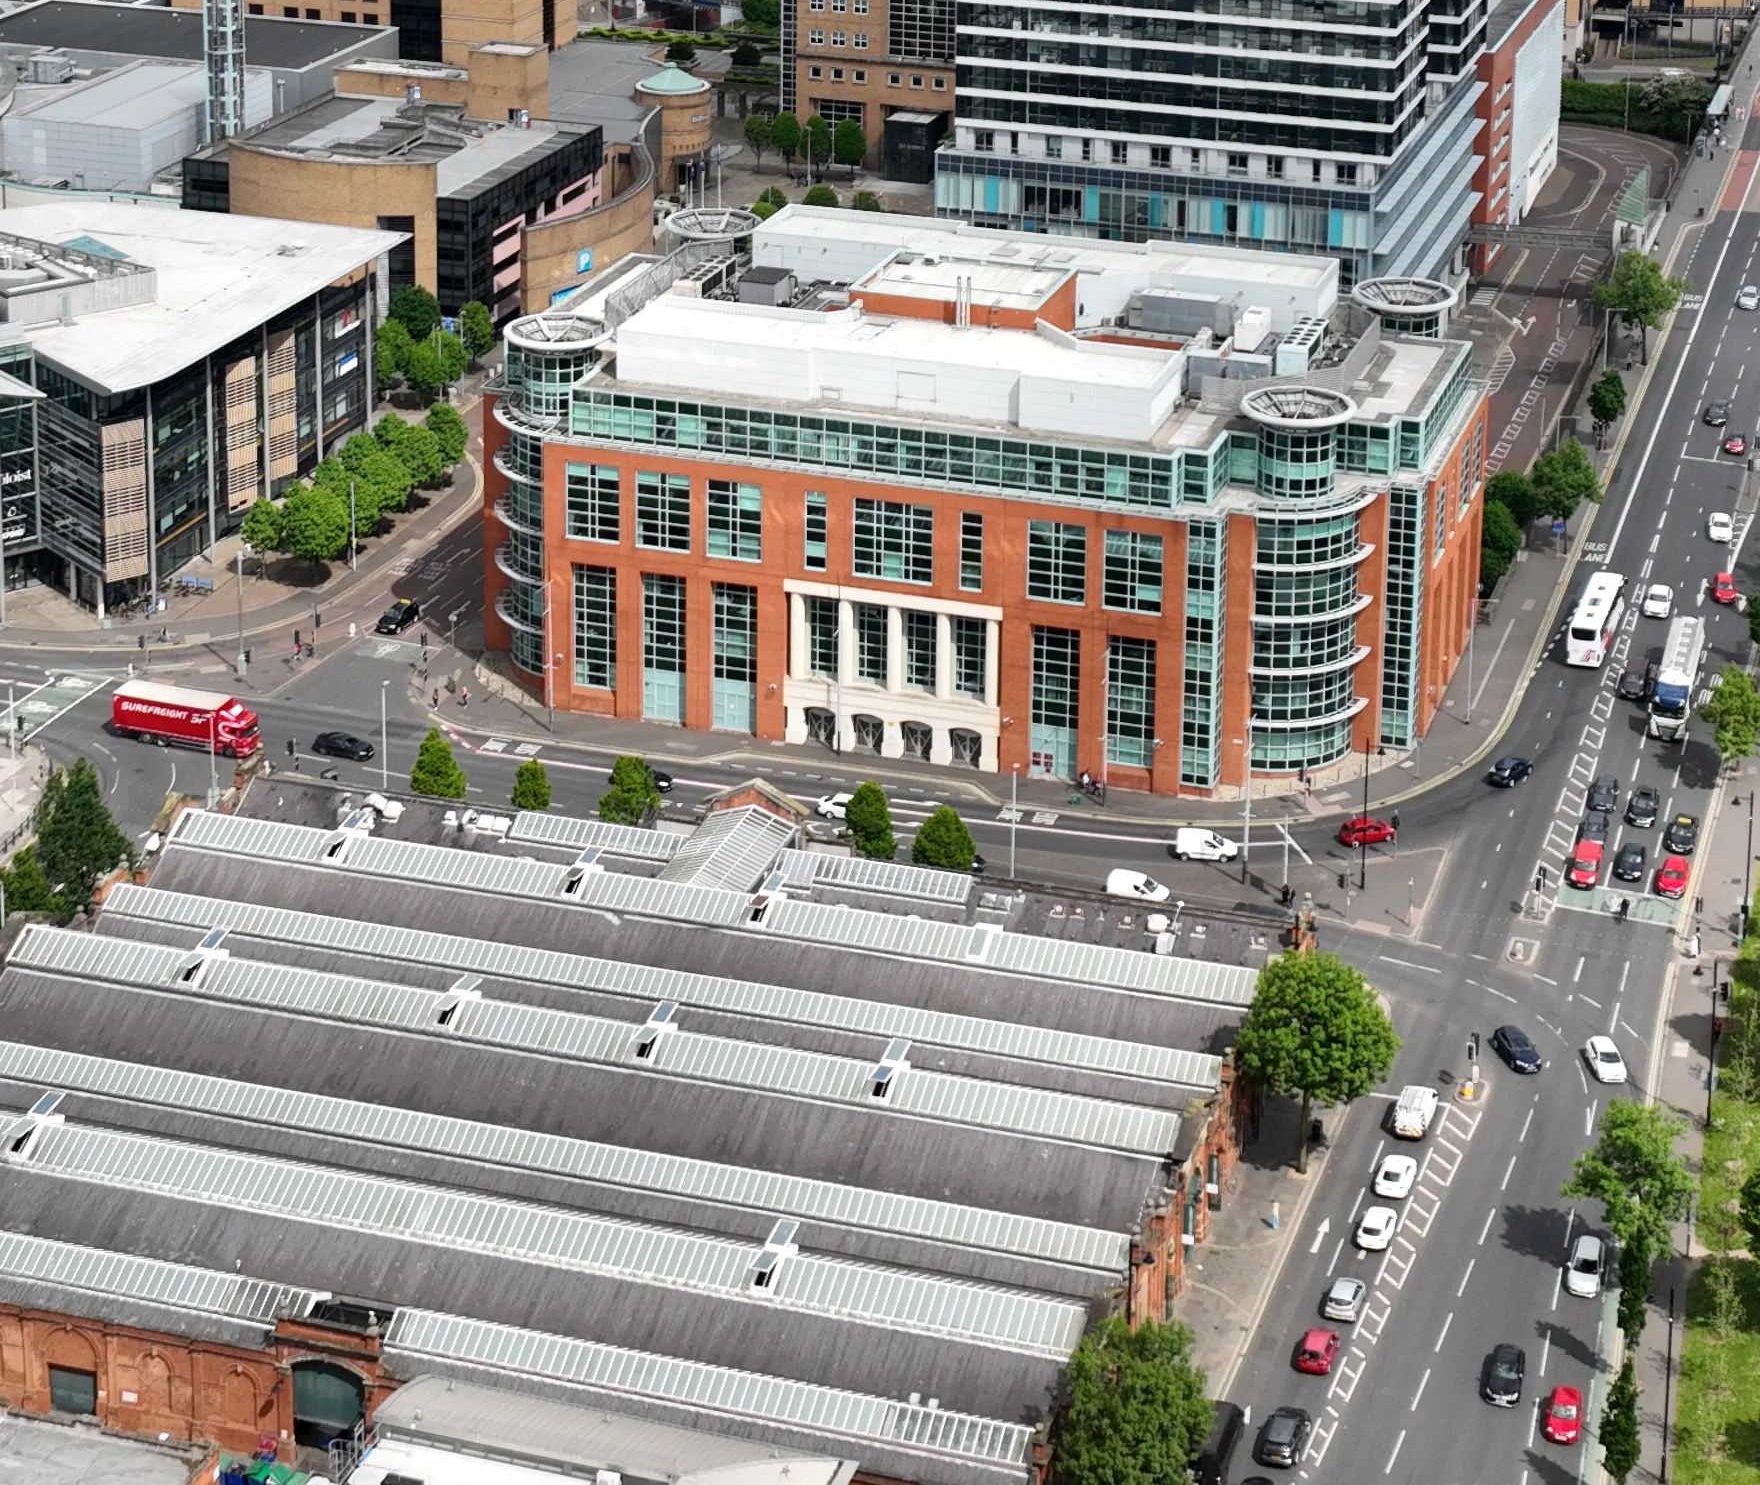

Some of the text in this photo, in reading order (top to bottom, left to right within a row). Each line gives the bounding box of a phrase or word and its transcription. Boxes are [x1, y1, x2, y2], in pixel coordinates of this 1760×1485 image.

[1683, 294, 1703, 302] BUS
[1584, 541, 1608, 552] BUS
[121, 701, 189, 720] SUREFREIGHT
